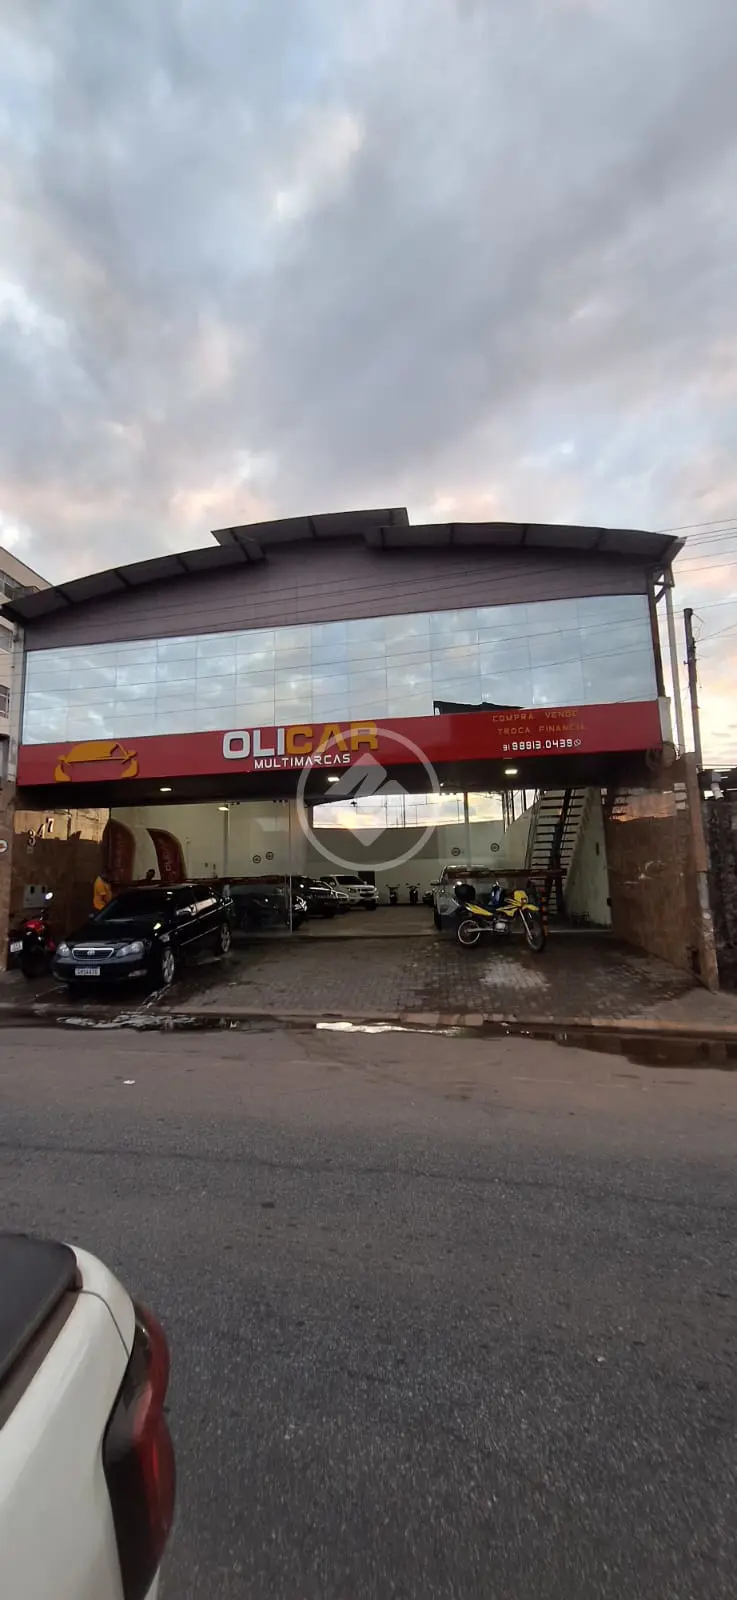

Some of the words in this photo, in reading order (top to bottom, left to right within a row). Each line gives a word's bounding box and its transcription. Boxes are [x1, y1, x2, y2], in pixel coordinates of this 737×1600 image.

[492, 713, 534, 723] COMPRA
[497, 726, 531, 736] TROCA
[222, 722, 379, 760] OLICAR
[254, 753, 351, 770] MULTIMARCAS
